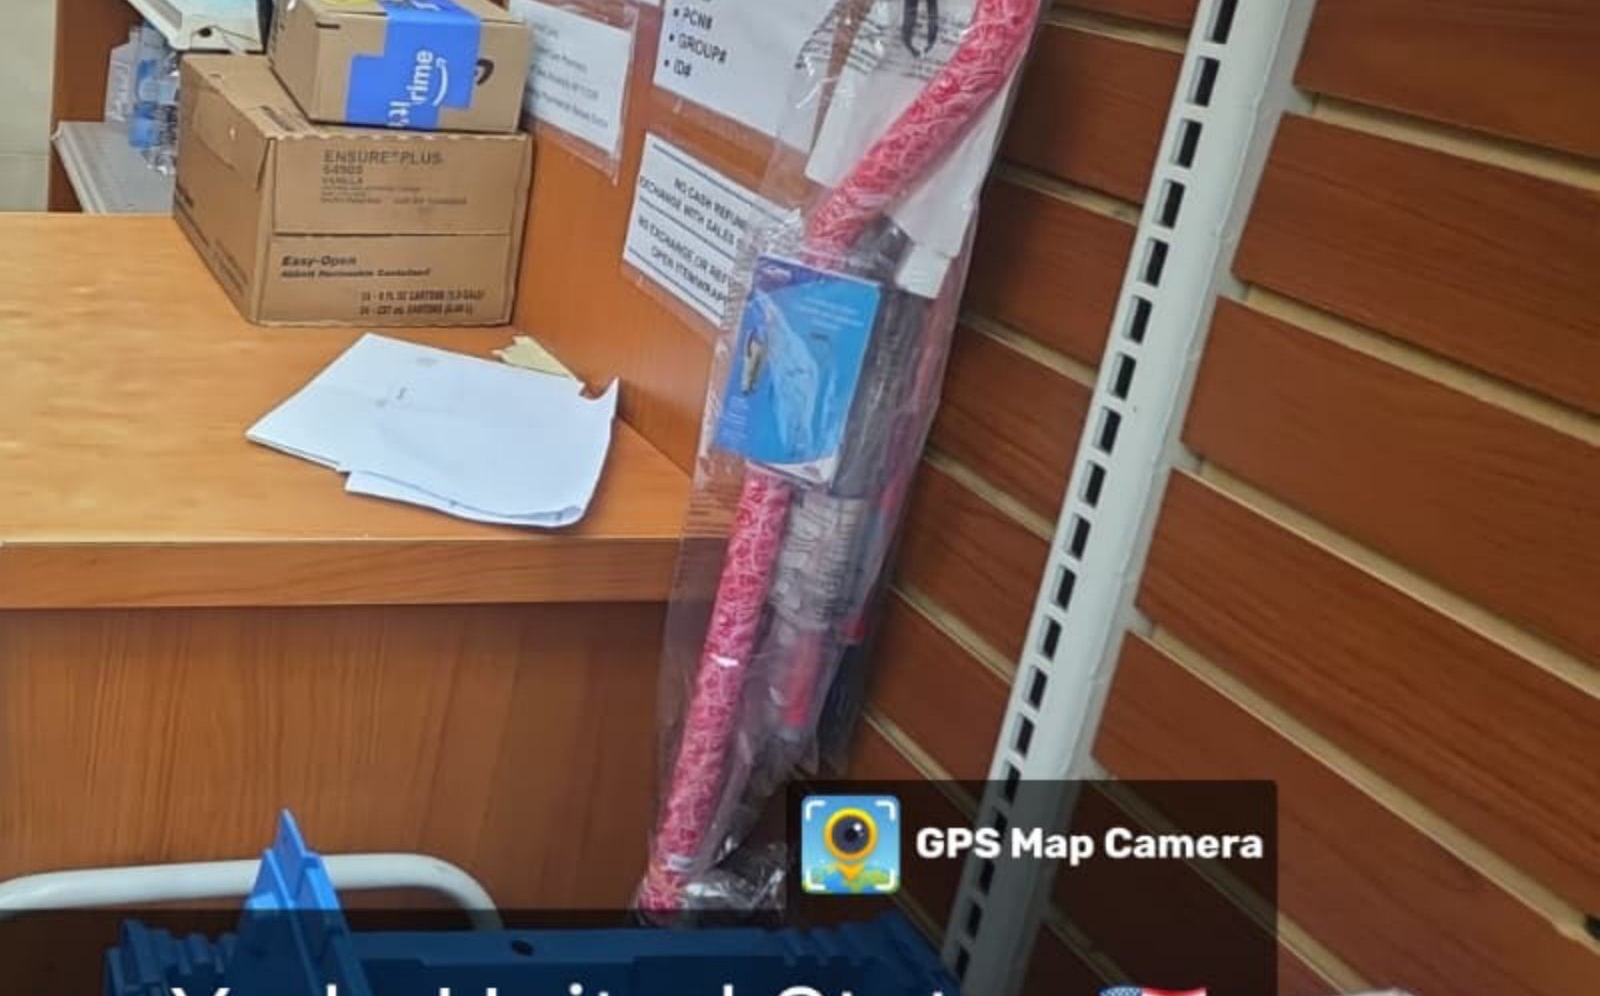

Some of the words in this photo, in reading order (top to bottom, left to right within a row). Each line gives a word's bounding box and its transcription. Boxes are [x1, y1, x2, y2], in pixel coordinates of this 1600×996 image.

[681, 6, 713, 30] PCN#
[677, 32, 728, 64] GROUP#
[405, 48, 434, 105] rime
[400, 150, 443, 165] PLUS
[281, 255, 357, 268] Easy-Open
